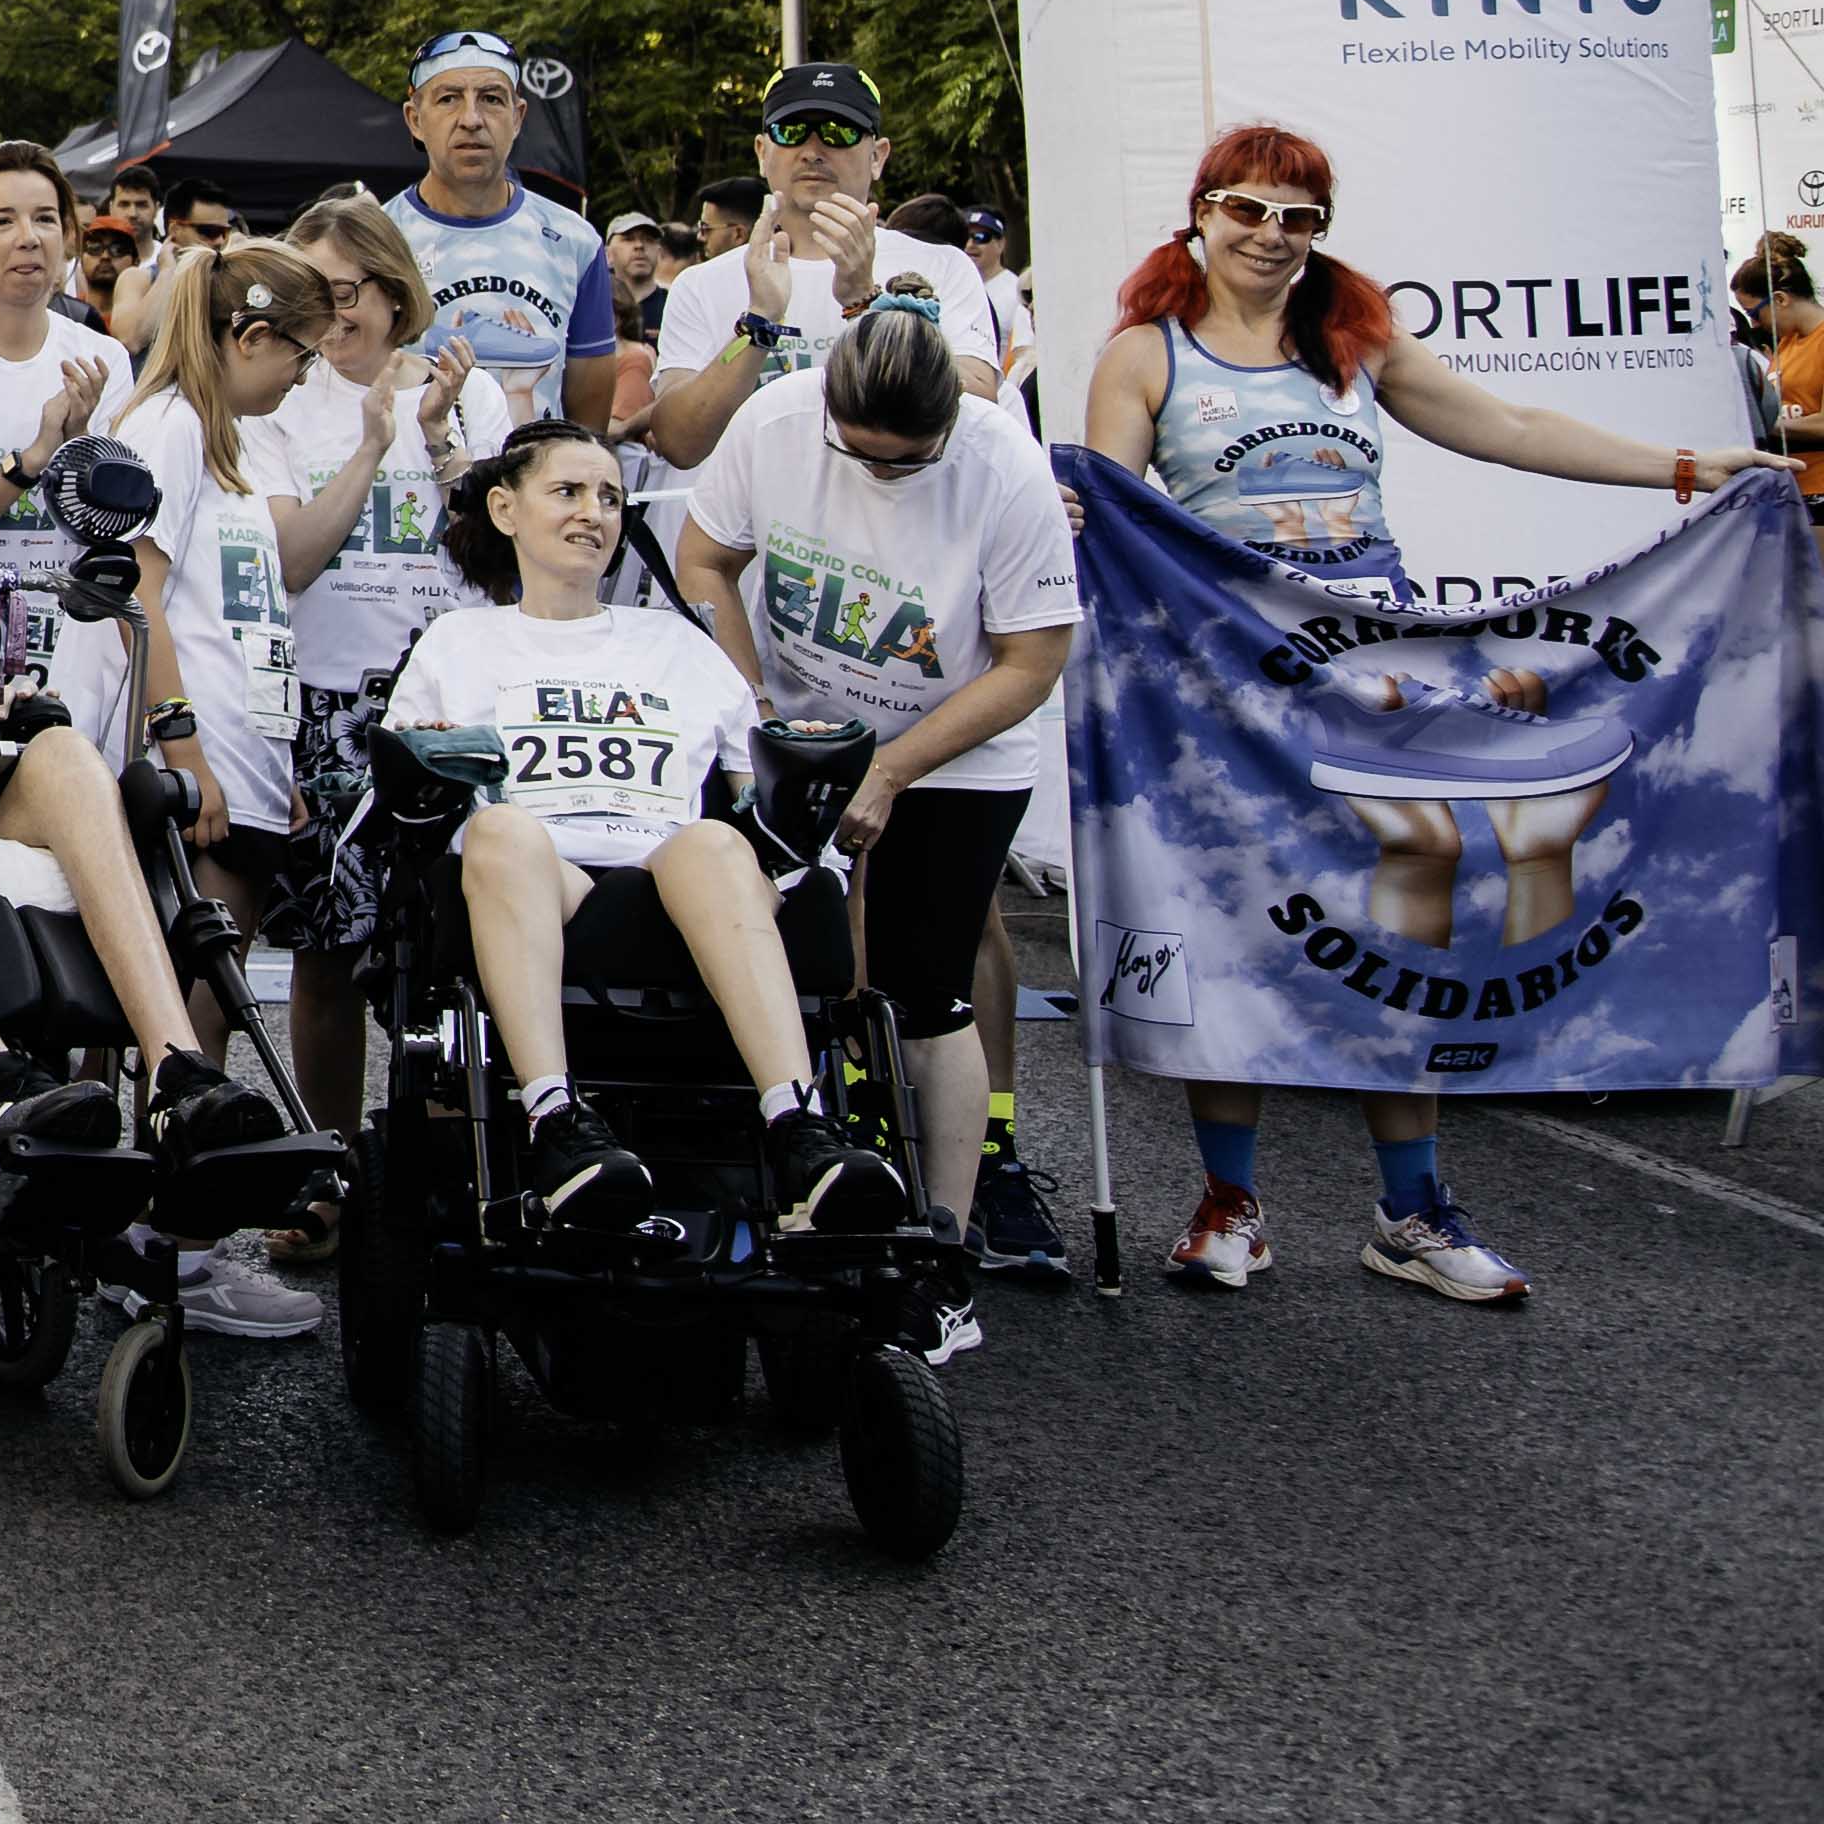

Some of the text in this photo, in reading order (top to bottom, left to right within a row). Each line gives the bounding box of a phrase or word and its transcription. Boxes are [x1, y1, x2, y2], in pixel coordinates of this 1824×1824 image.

[1342, 35, 1669, 65] Flexible Mobility Solutions
[433, 275, 562, 328] RREDORES
[1606, 350, 1619, 369] Y
[1624, 348, 1694, 370] EVENTOS
[1202, 411, 1238, 424] Madrid
[1214, 422, 1379, 473] CORREDORES
[767, 532, 924, 601] MADRID CON LA
[764, 549, 945, 679] ELA
[535, 678, 624, 689] MADRID CON LA
[846, 686, 923, 713] MUKUA
[535, 686, 646, 726] ELA
[511, 735, 674, 787] 2587
[1266, 888, 1646, 1022] SOLIDARIOS
[1433, 1047, 1492, 1069] 42K
